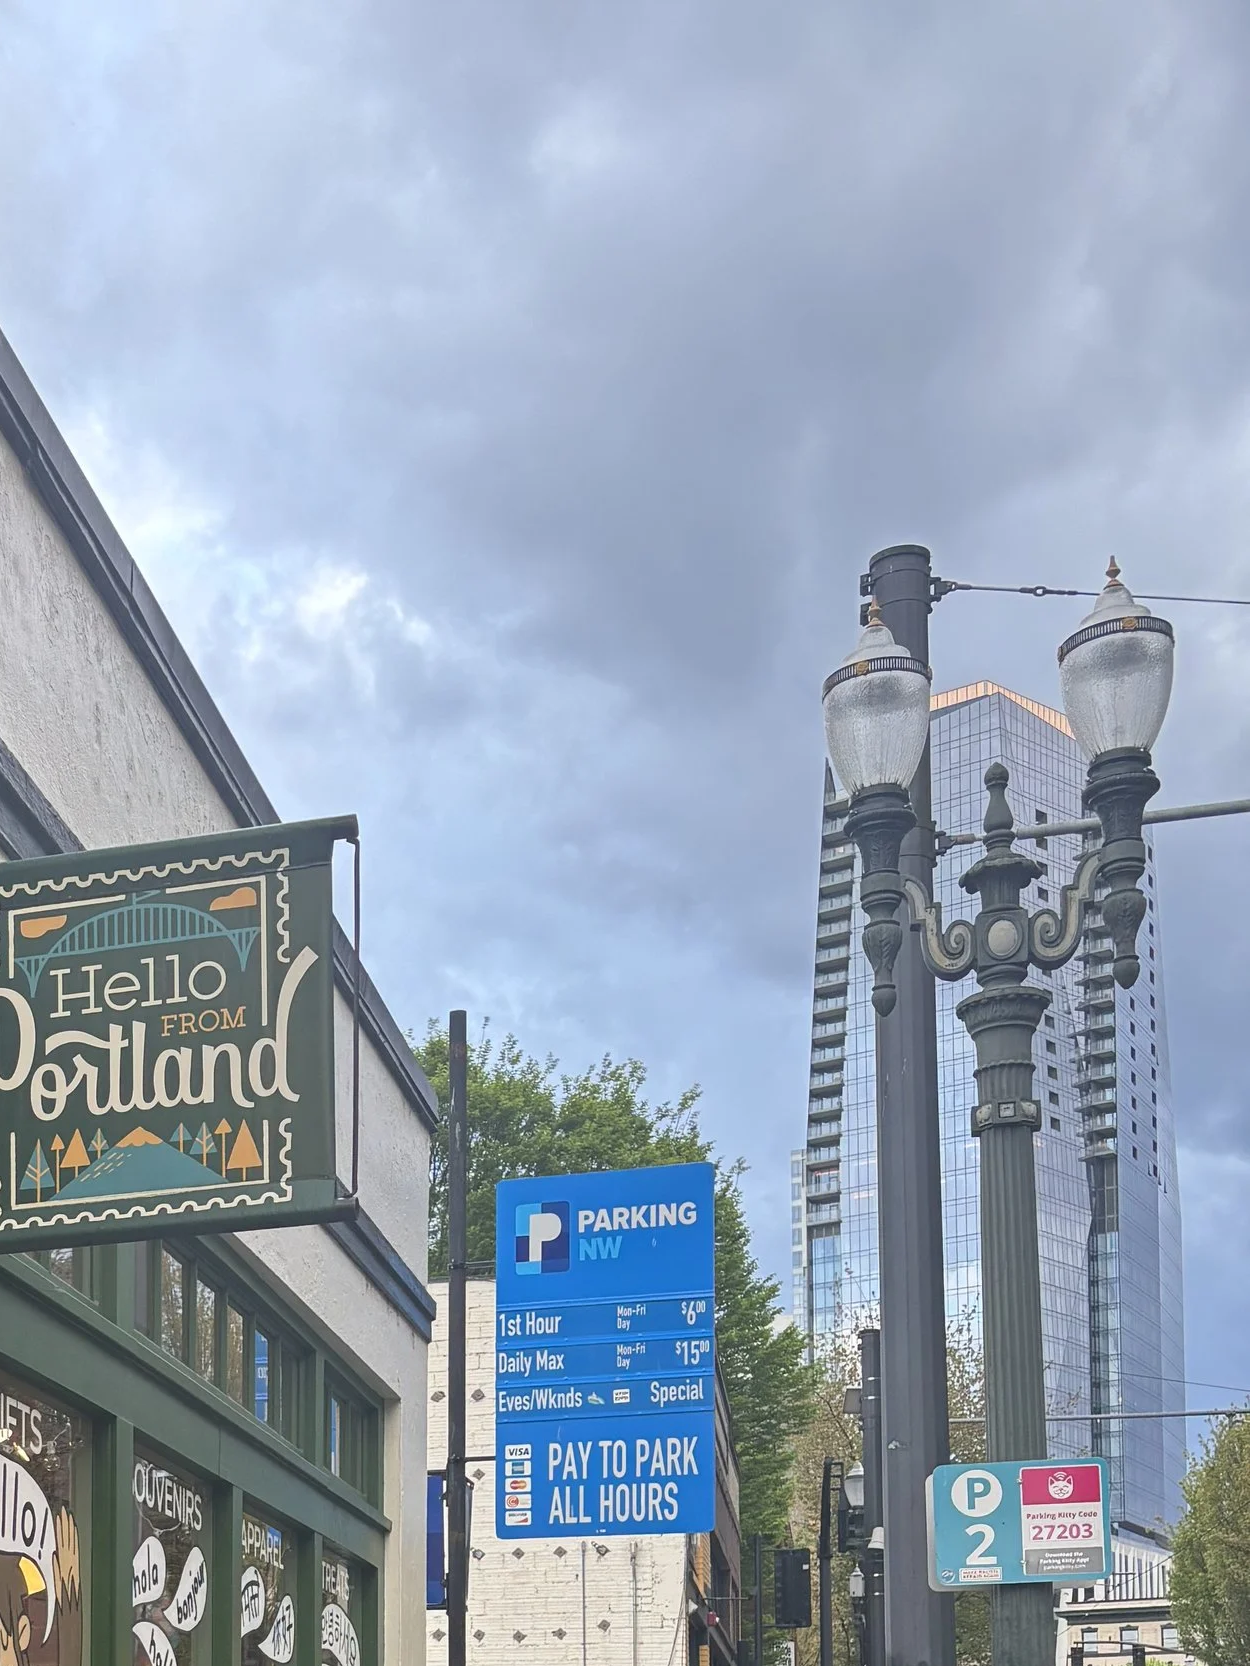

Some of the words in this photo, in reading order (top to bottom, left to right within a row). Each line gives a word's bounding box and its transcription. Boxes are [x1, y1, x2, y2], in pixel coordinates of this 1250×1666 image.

[50, 954, 227, 1018] Hello
[161, 1006, 247, 1037] FROM
[578, 1201, 698, 1234] PARKING
[579, 1236, 623, 1261] NW
[499, 1315, 522, 1337] 1st
[526, 1313, 562, 1335] Hour
[617, 1304, 646, 1317] Mon-Fri
[617, 1318, 630, 1331] Day
[617, 1342, 646, 1355] Mon-Fri
[617, 1356, 630, 1370] Day
[499, 1352, 531, 1378] Daily
[535, 1350, 565, 1371] Max
[498, 1387, 583, 1413] Eves/Wknds
[650, 1378, 704, 1408] Special
[508, 1447, 529, 1457] VISA
[549, 1441, 593, 1481] PAY
[598, 1439, 627, 1479] TO
[635, 1436, 699, 1477] PARK
[132, 1462, 202, 1531] OUVENIRS
[549, 1485, 592, 1524] ALL
[600, 1482, 679, 1522] HOURS
[966, 1477, 991, 1510] P
[1026, 1511, 1056, 1520] Parking
[1058, 1510, 1077, 1520] Kitty
[1078, 1510, 1097, 1518] Code
[241, 1519, 284, 1570] APPAREL
[964, 1523, 998, 1565] 2
[1032, 1523, 1094, 1541] 27203
[176, 1560, 206, 1625] bonjour
